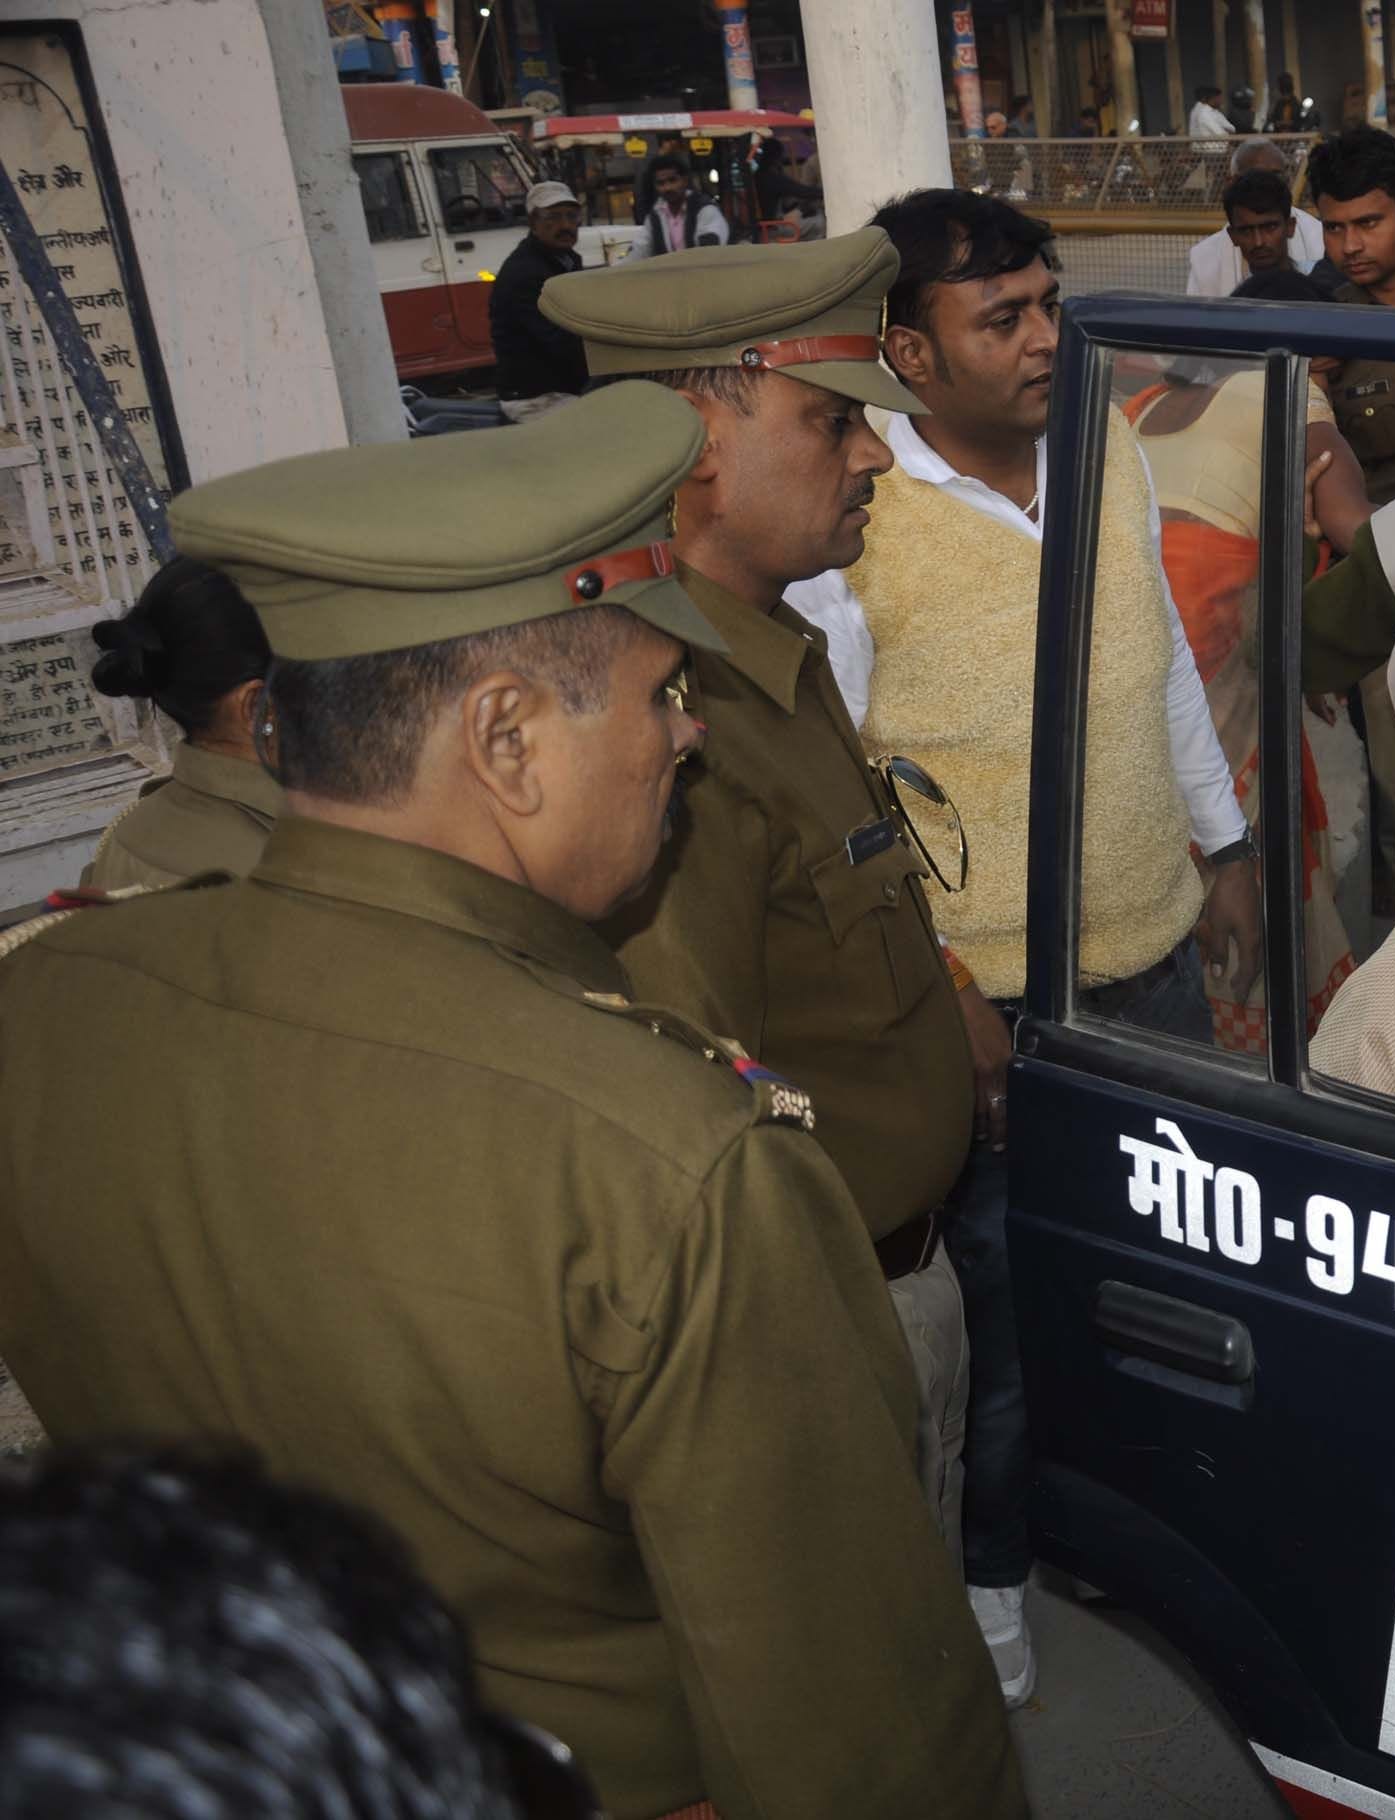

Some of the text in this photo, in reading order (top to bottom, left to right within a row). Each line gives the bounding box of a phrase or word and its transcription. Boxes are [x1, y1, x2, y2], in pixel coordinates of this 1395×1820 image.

[1135, 0, 1167, 16] ATM
[52, 164, 86, 188] और
[101, 344, 135, 368] और
